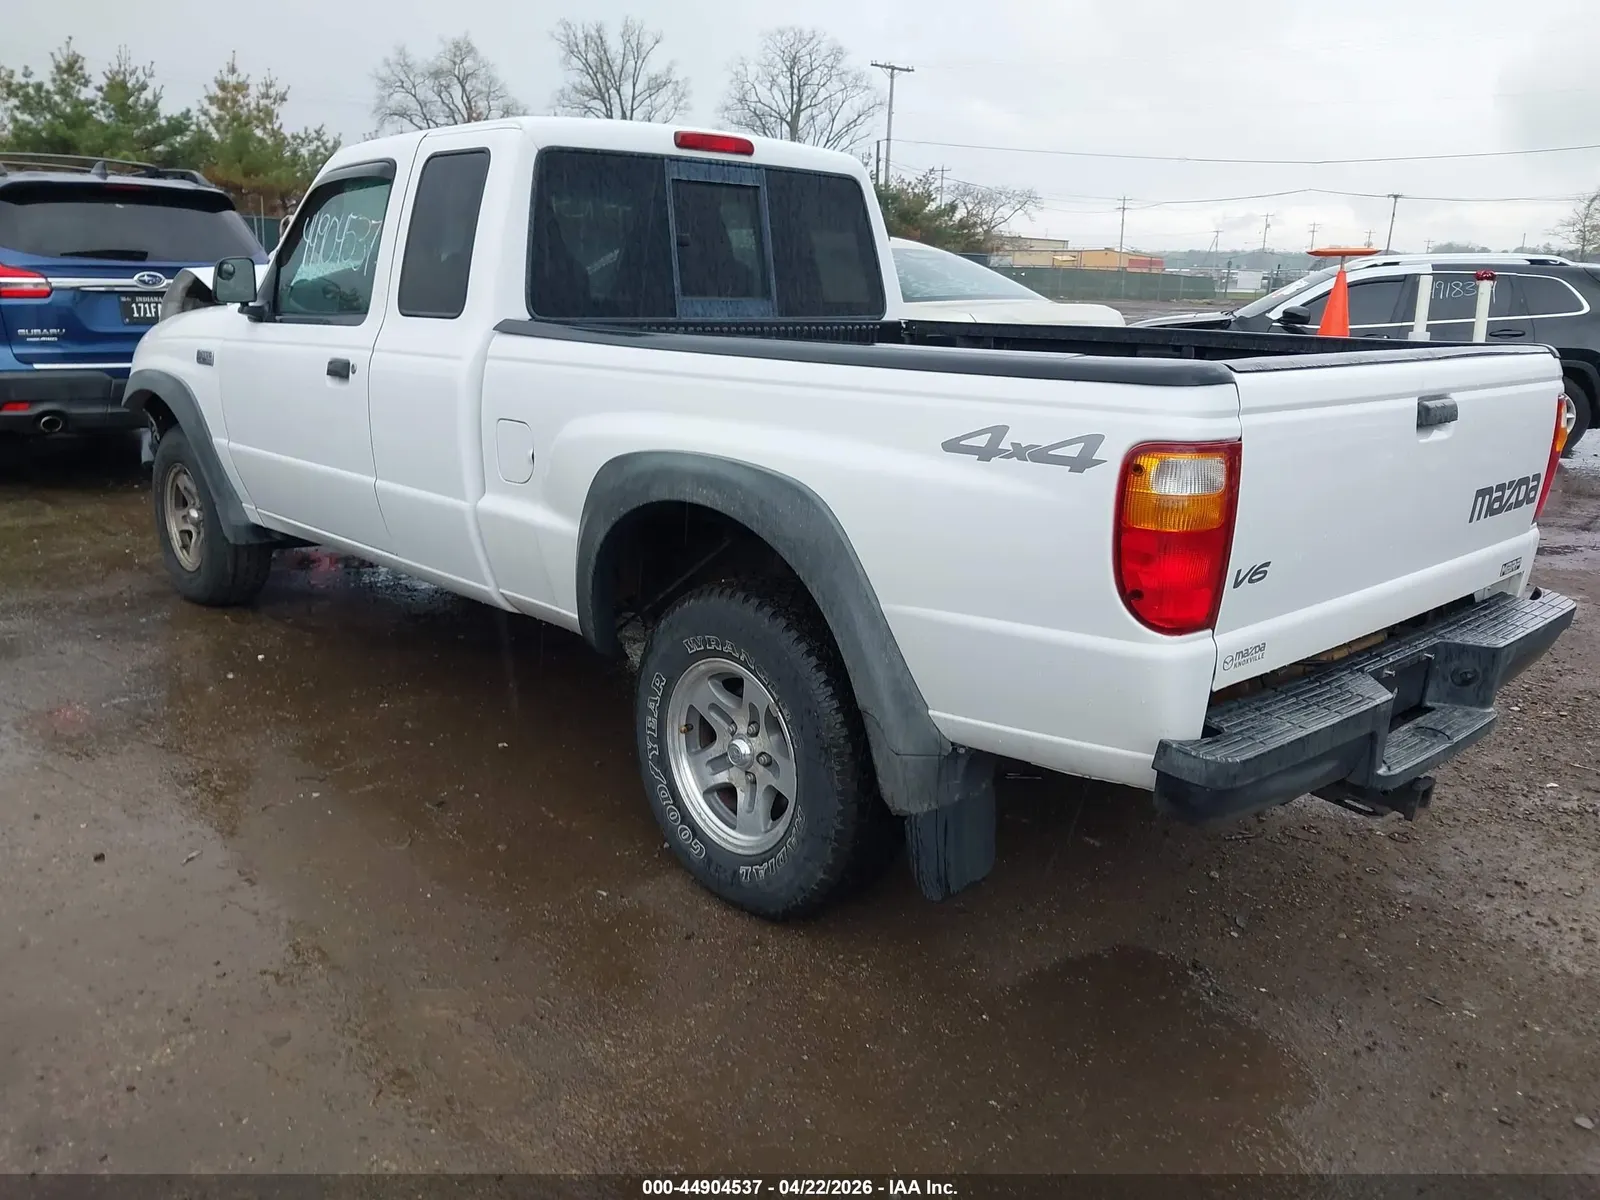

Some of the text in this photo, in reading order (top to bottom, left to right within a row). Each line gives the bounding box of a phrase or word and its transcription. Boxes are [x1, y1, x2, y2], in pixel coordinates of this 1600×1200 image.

[940, 424, 1108, 474] 4x4
[1232, 560, 1272, 590] V6
[1232, 651, 1266, 669] KNOXVILLE
